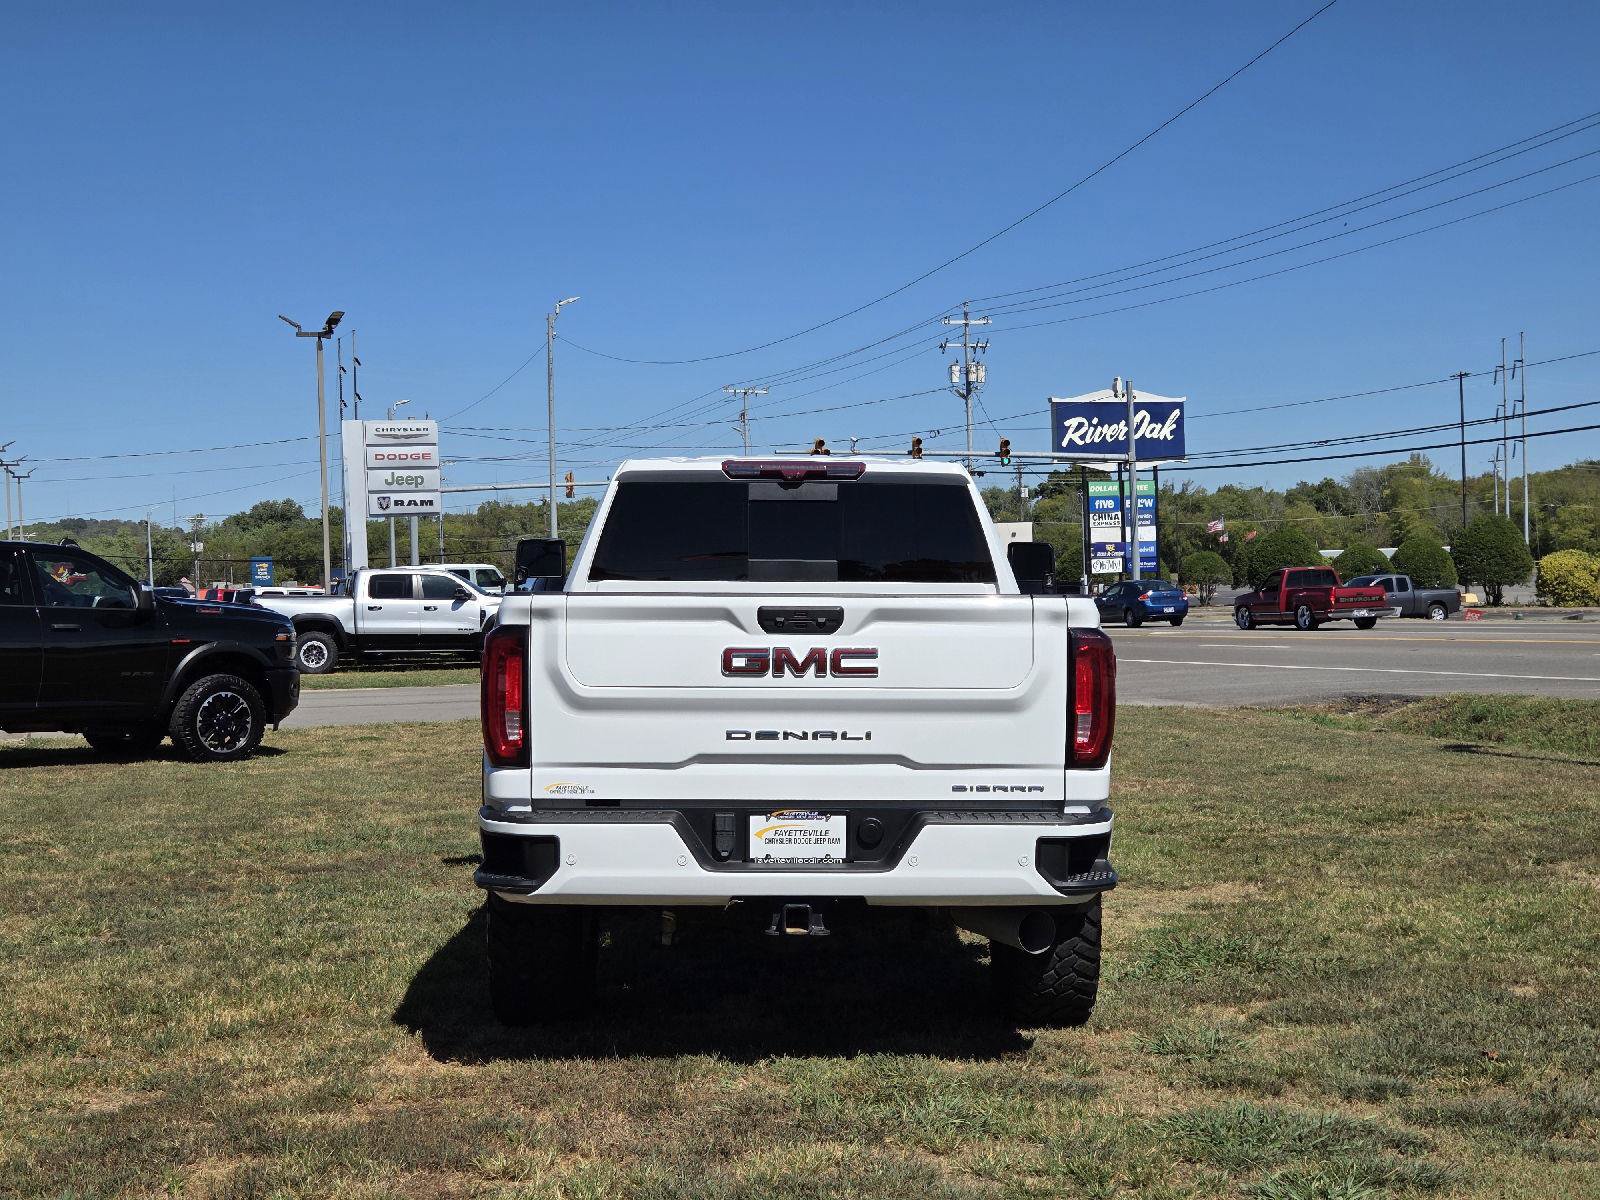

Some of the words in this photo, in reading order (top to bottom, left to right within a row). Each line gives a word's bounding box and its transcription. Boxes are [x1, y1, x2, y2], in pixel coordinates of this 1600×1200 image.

[1061, 416, 1129, 448] River
[1133, 408, 1181, 440] Oak
[374, 452, 432, 461] DODGE
[384, 471, 425, 489] Jeep
[393, 499, 434, 507] RAM
[1092, 513, 1120, 522] CHINA
[721, 647, 879, 679] GMC
[725, 730, 872, 741] DENALI
[951, 785, 1045, 793] SIERRA
[774, 829, 831, 837] FAYETTEVILLE
[764, 837, 792, 845] CHRYSLER
[793, 837, 812, 845] DODGE
[813, 837, 827, 845] JEEP
[827, 837, 841, 845] RAM
